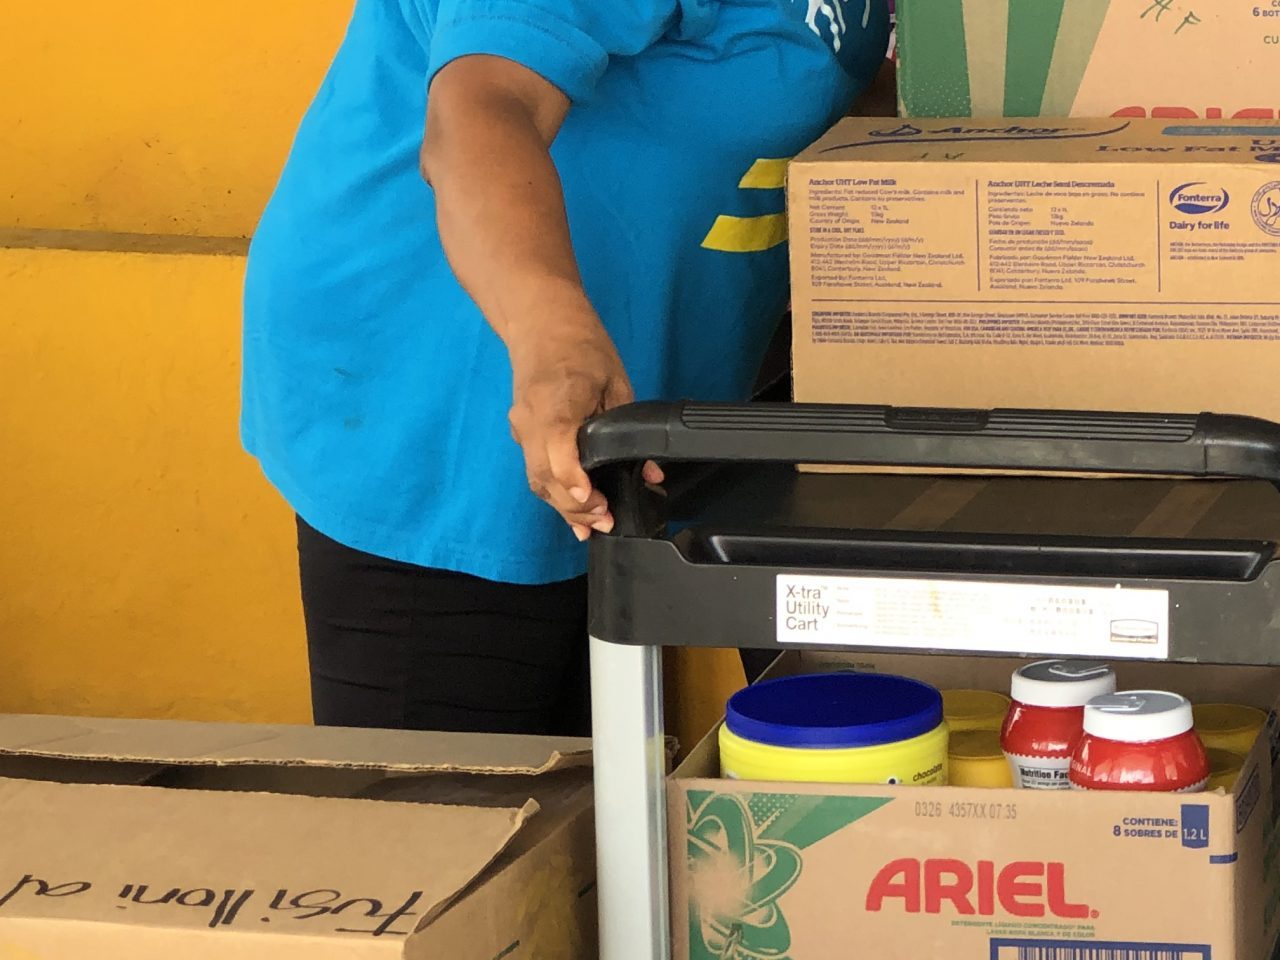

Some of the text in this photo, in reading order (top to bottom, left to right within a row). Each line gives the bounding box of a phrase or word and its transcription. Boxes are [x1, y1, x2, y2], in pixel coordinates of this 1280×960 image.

[1252, 8, 1260, 17] 6
[928, 123, 1070, 137] Anchor
[1178, 194, 1222, 202] Fonterra
[1169, 221, 1230, 231] Dairy for life
[785, 585, 822, 600] X-tra
[785, 600, 830, 619] Utility
[785, 617, 819, 632] Cart
[1020, 768, 1052, 779] Nutrition
[915, 801, 942, 817] 0326
[1122, 817, 1178, 827] CONTIENE:
[1113, 826, 1121, 837] 8
[1124, 829, 1162, 838] SOBRES
[1164, 830, 1178, 838] DE
[864, 858, 1089, 919] ARIEL
